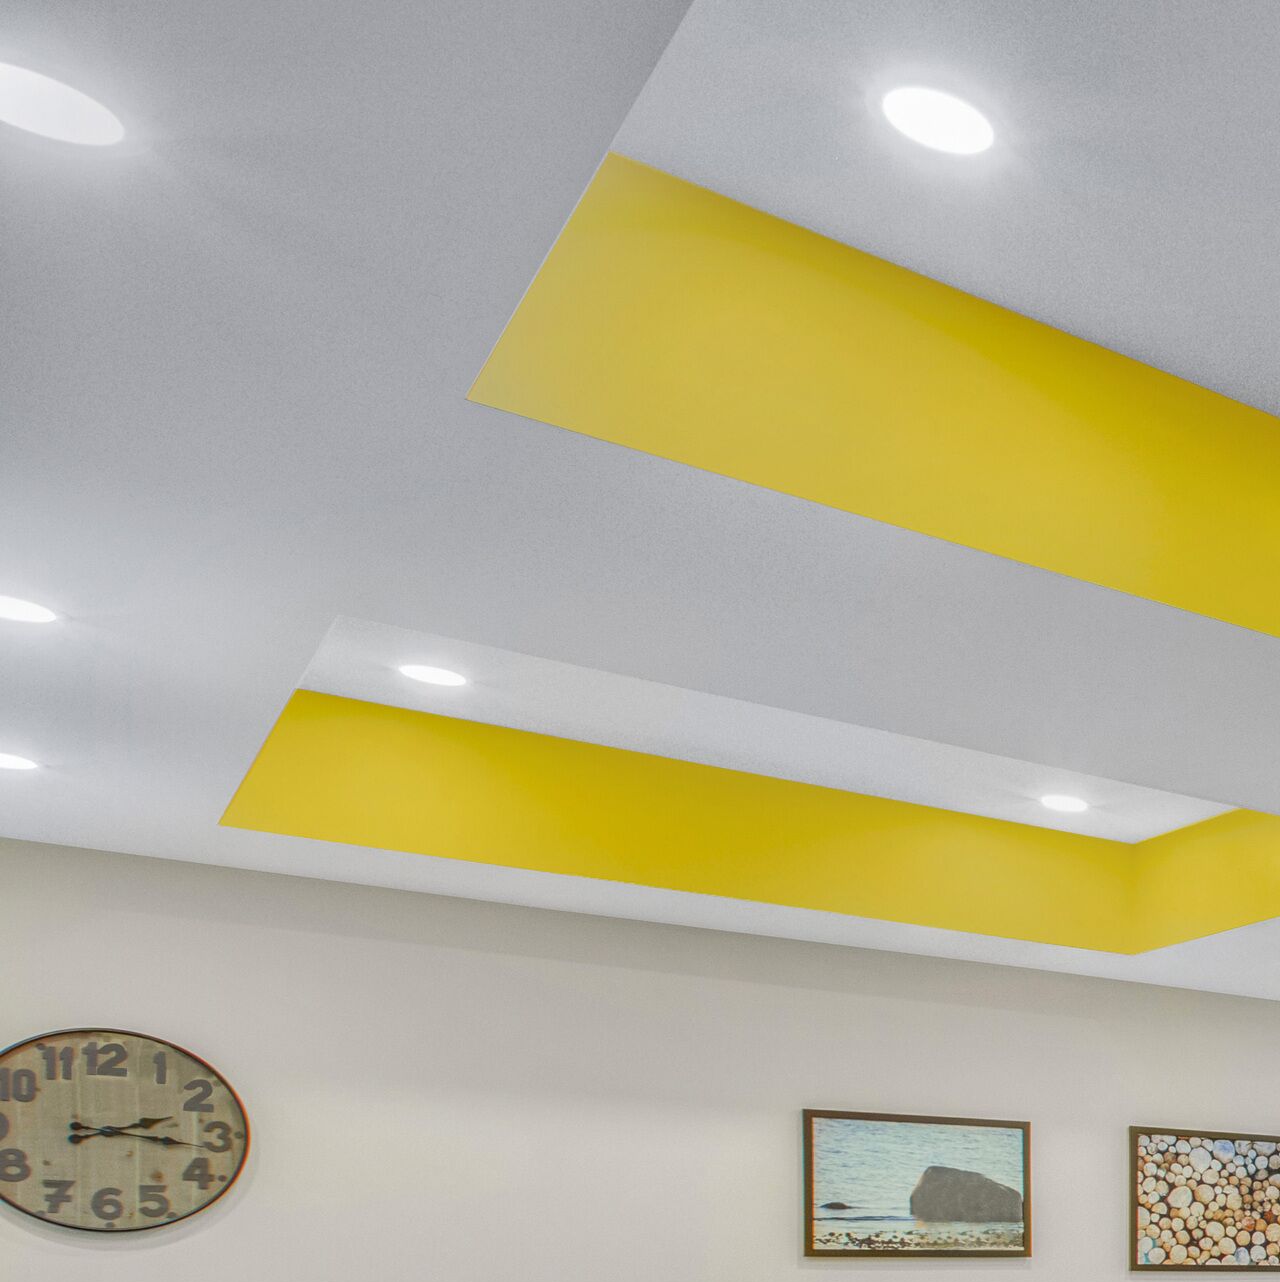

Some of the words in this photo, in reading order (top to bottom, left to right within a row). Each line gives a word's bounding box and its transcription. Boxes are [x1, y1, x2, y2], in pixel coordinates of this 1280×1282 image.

[41, 1045, 74, 1080] 11
[82, 1042, 127, 1077] 12
[153, 1051, 167, 1084] 1
[183, 1079, 214, 1113] 2
[203, 1121, 233, 1153] 3
[183, 1157, 214, 1190] 4
[42, 1179, 76, 1213] 7
[91, 1187, 123, 1221] 6
[139, 1185, 169, 1218] 5
